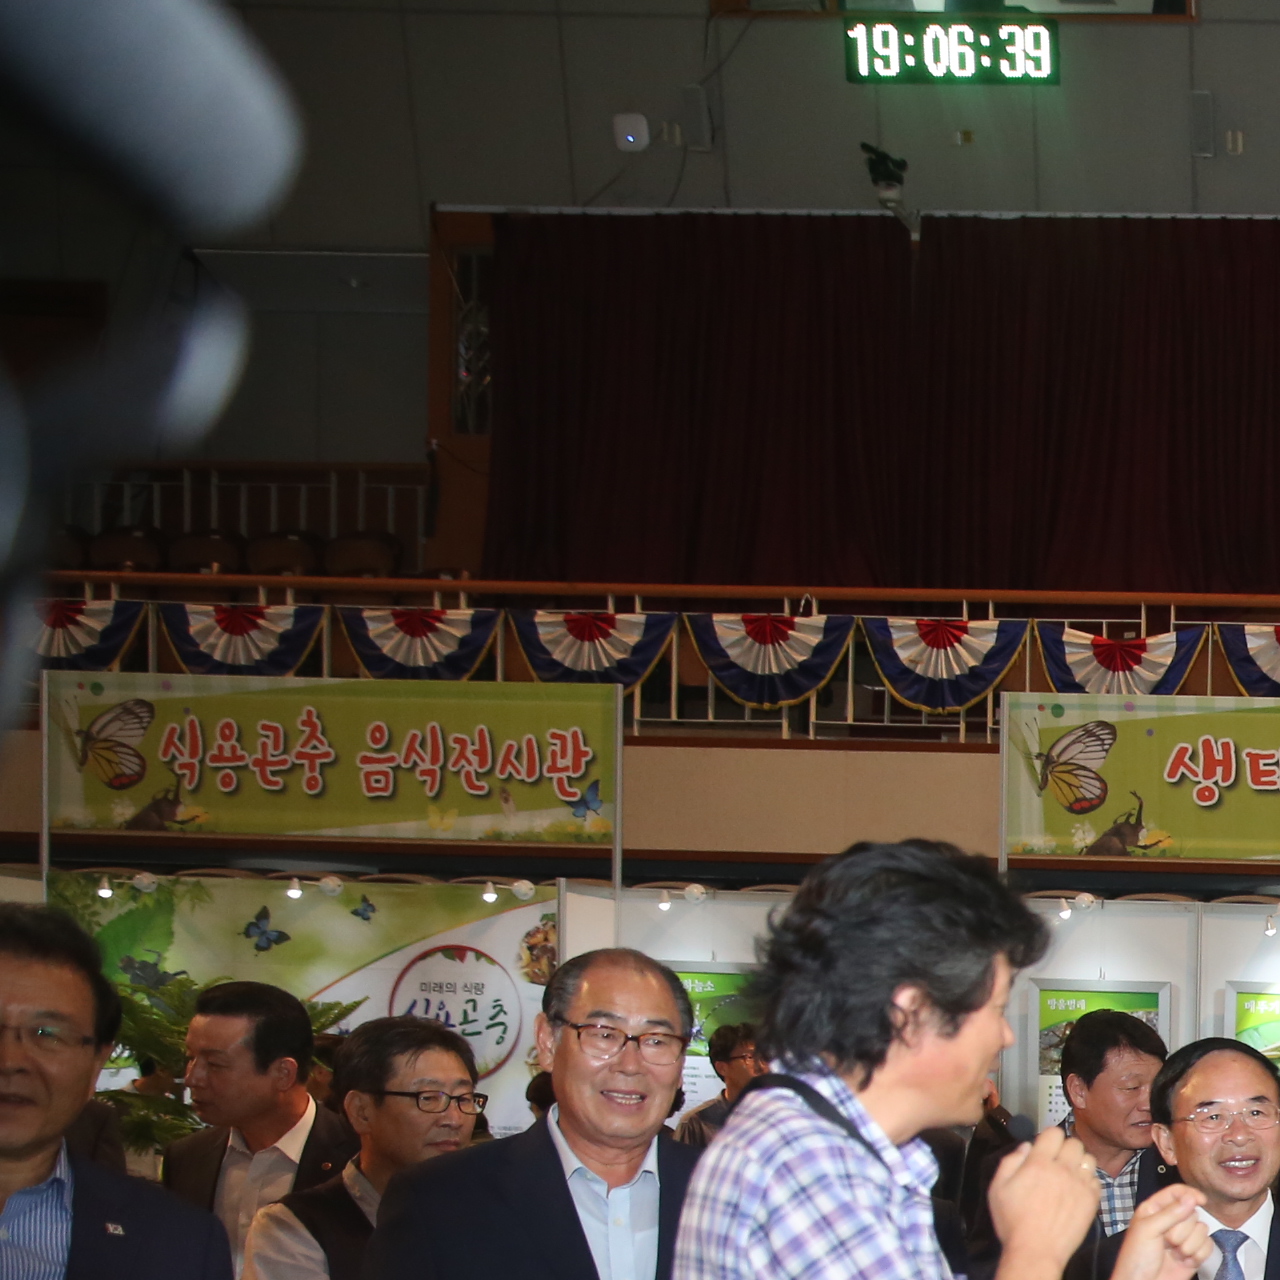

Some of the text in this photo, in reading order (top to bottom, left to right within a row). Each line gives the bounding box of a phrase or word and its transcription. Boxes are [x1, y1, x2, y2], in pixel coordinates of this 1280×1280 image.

[847, 23, 1051, 77] 19:06:39
[159, 705, 595, 801] 식용곤충 음식전시관
[420, 982, 485, 995] 미래의 식량
[1047, 998, 1086, 1011] 방울벌레
[1244, 999, 1280, 1014] 메뚜기
